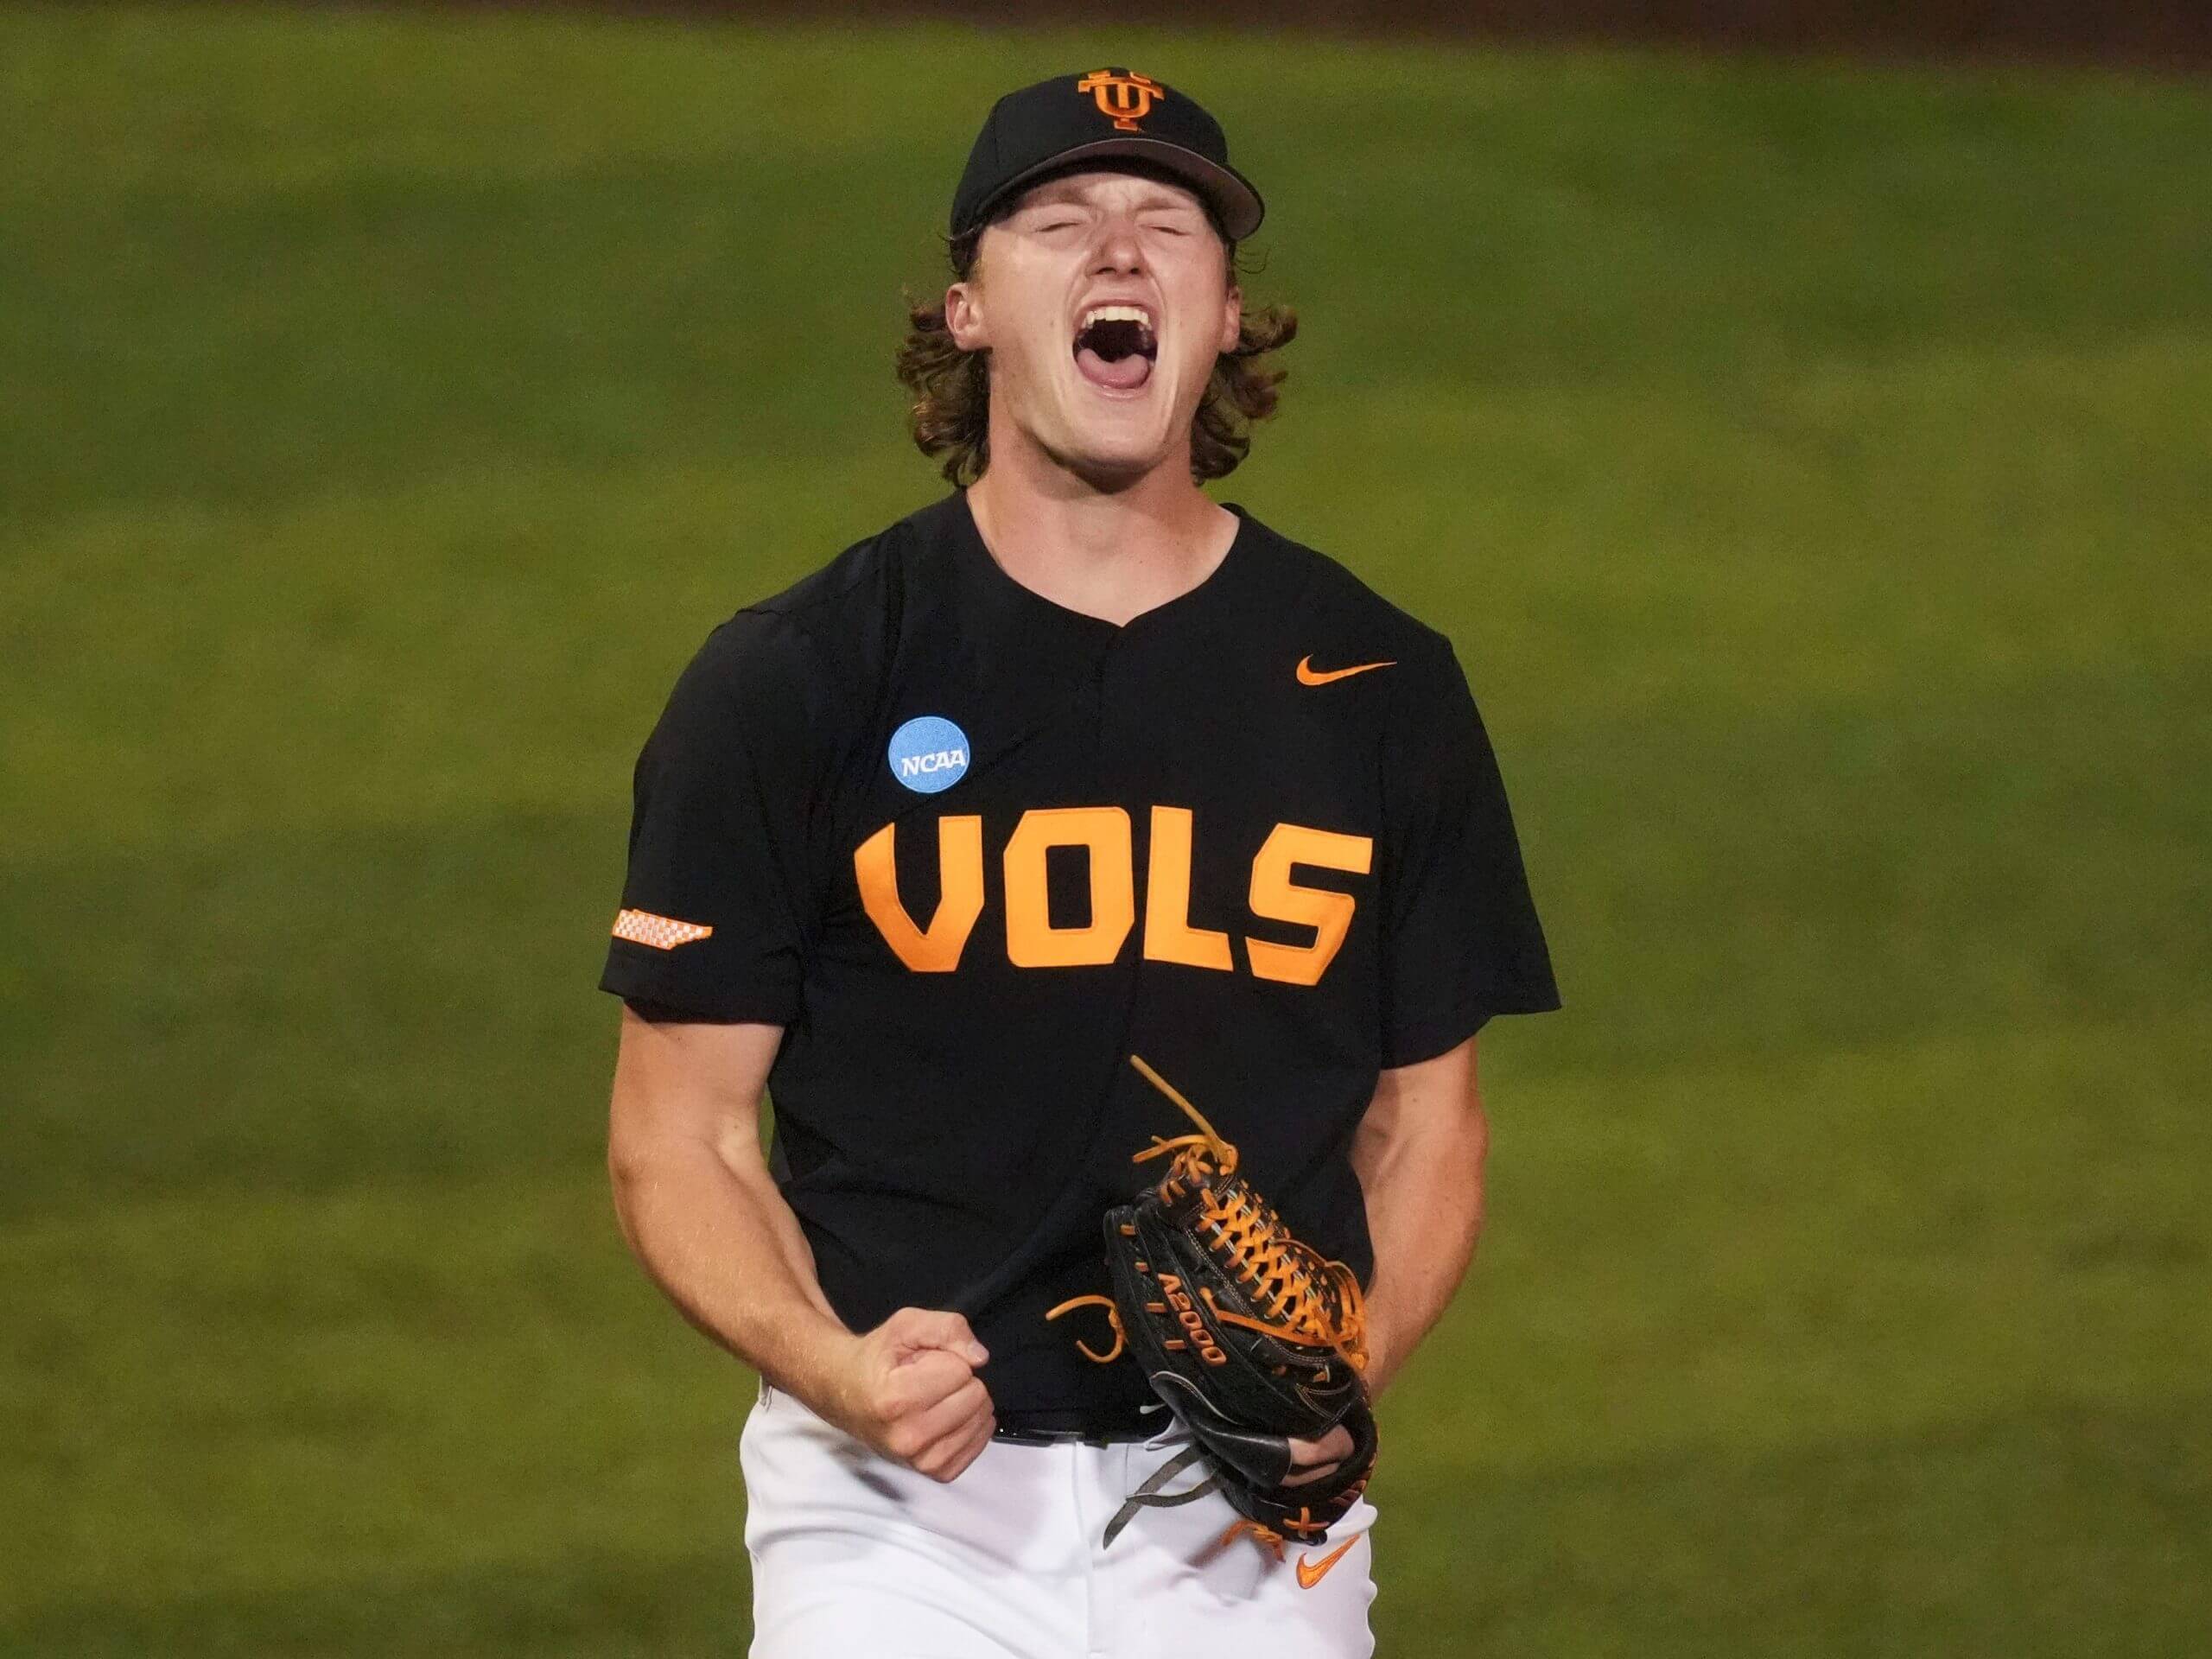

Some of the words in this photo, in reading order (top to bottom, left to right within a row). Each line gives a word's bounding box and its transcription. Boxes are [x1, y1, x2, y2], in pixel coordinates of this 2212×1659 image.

[901, 749, 966, 777] NCAA
[854, 805, 1374, 986] VOLS
[1158, 1273, 1227, 1365] A2000
